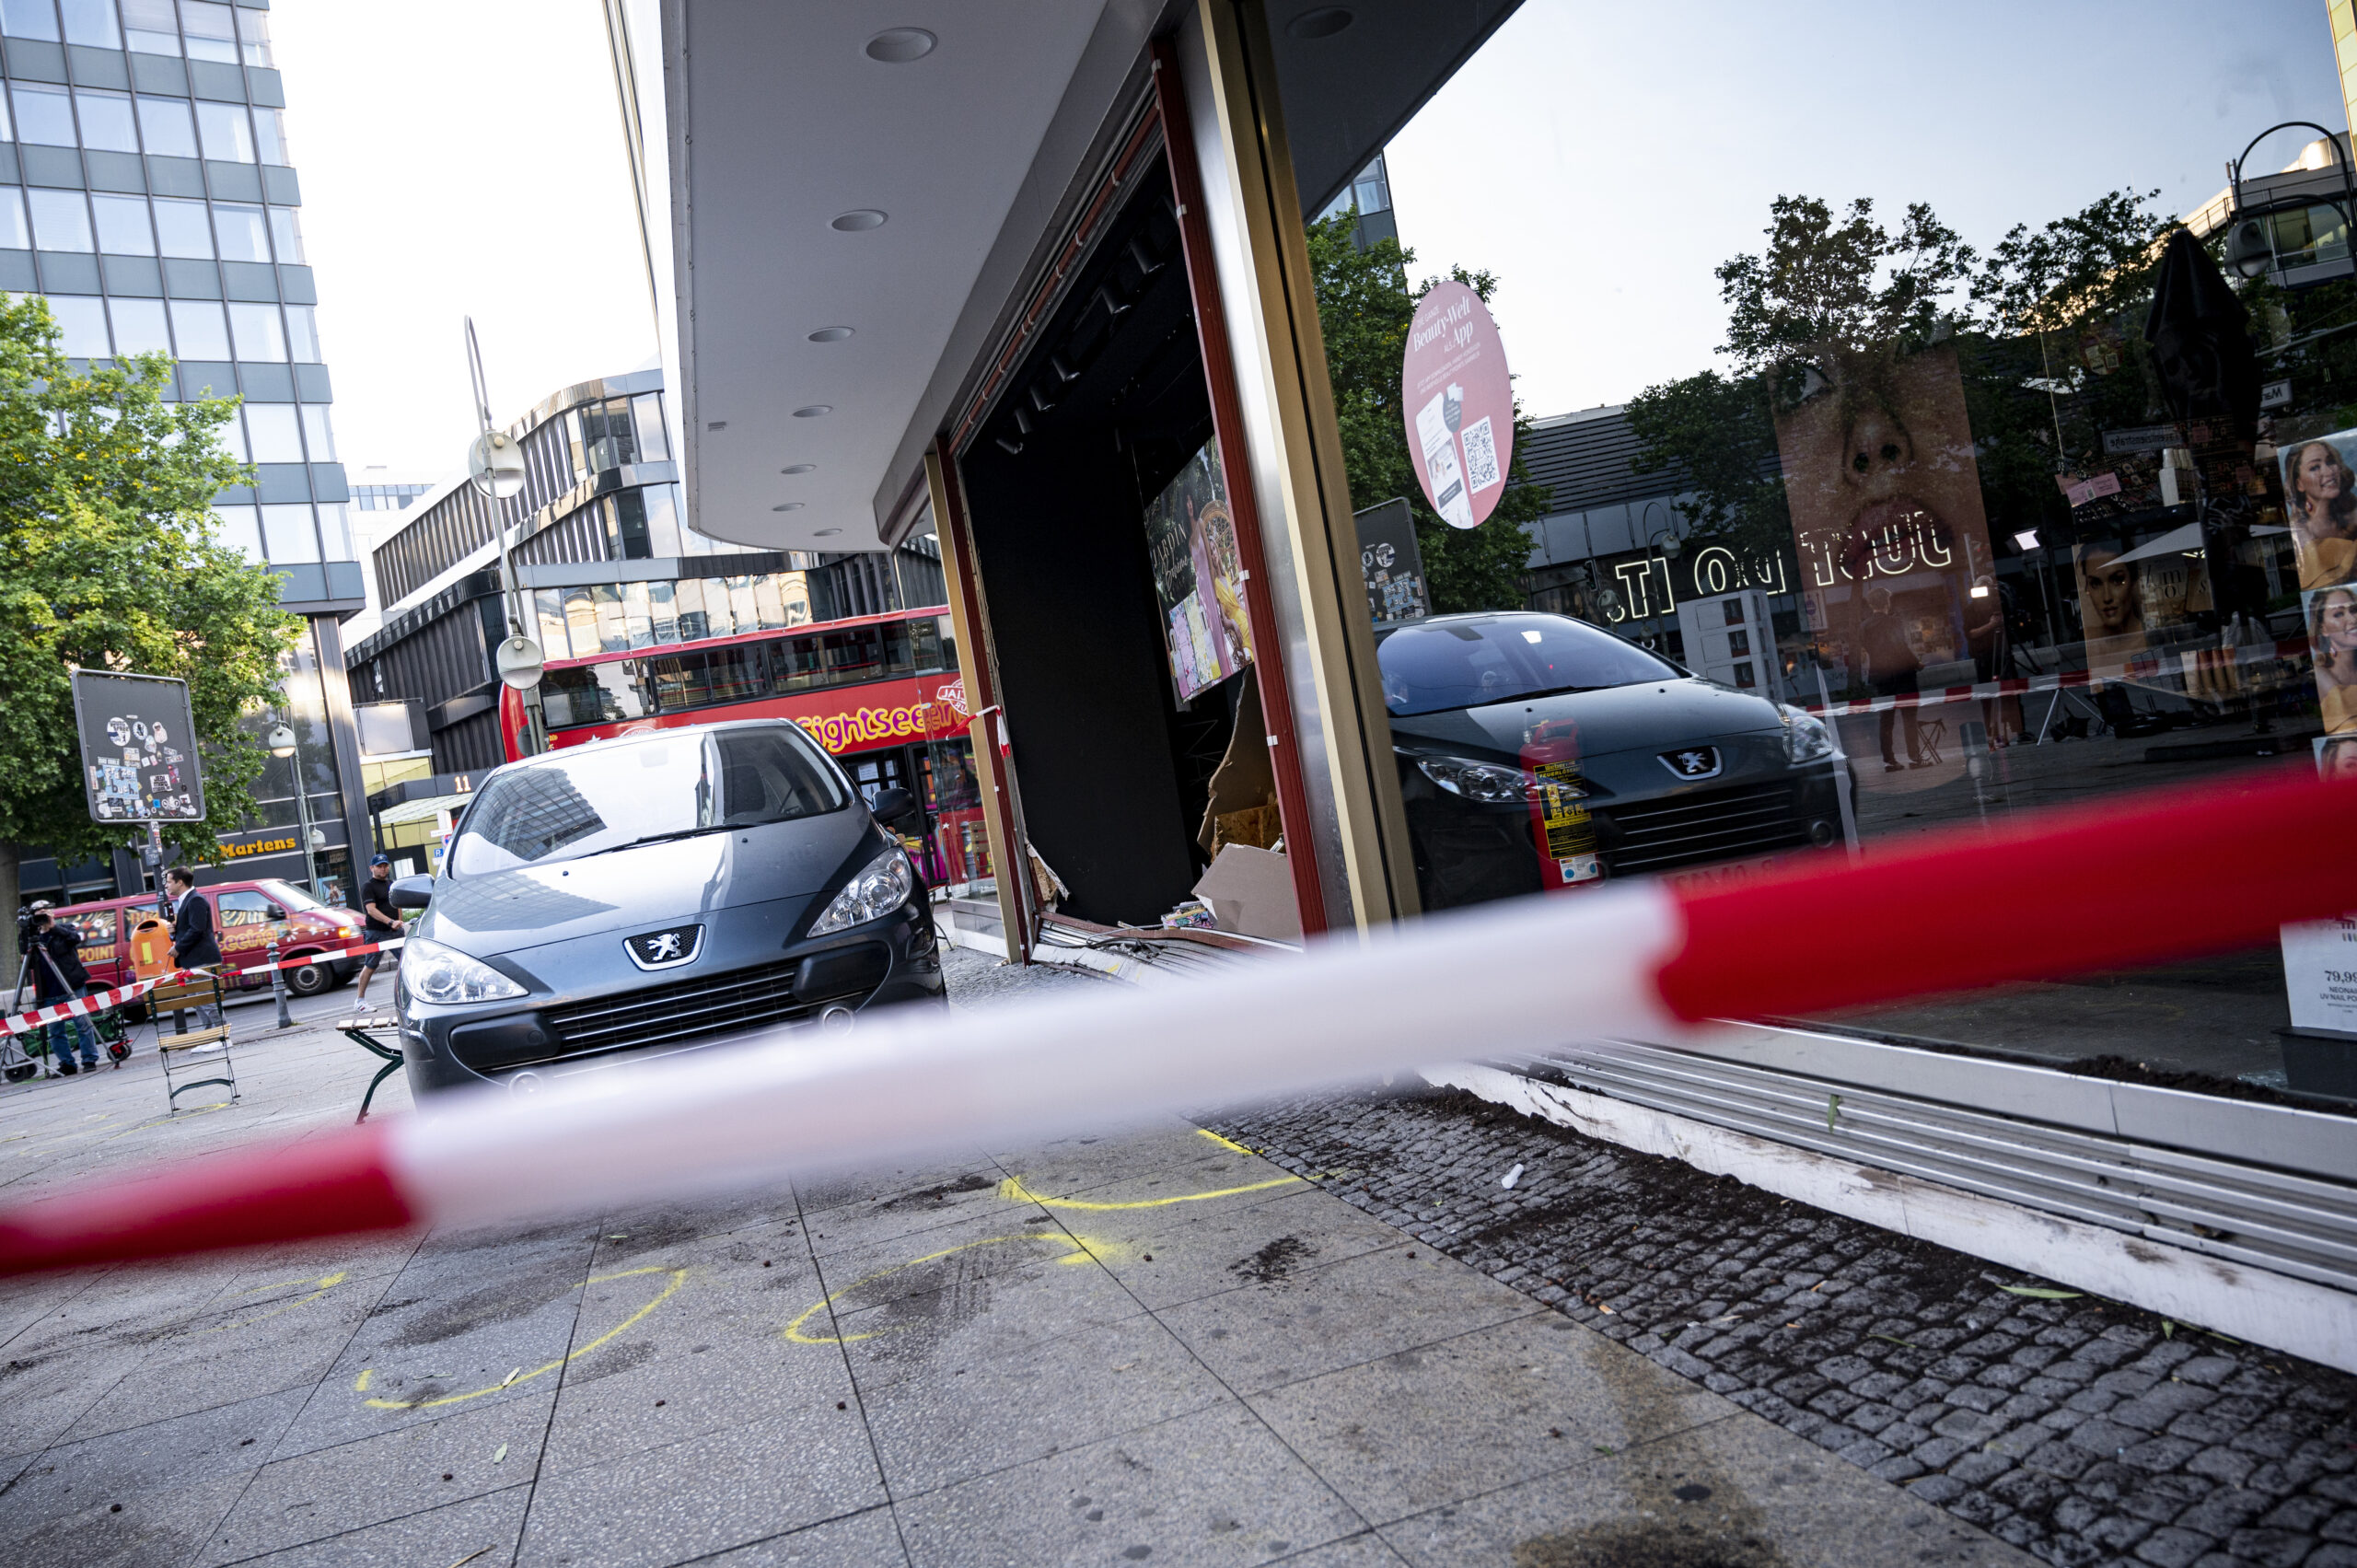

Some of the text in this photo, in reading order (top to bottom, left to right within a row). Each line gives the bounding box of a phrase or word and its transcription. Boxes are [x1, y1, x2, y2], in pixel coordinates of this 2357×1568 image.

[1413, 296, 1470, 352] Beauty-Welt
[1454, 321, 1473, 348] App
[1152, 523, 1187, 568] JARDIN
[455, 775, 470, 793] 11
[218, 837, 296, 859] Martens
[78, 945, 116, 961] POINT
